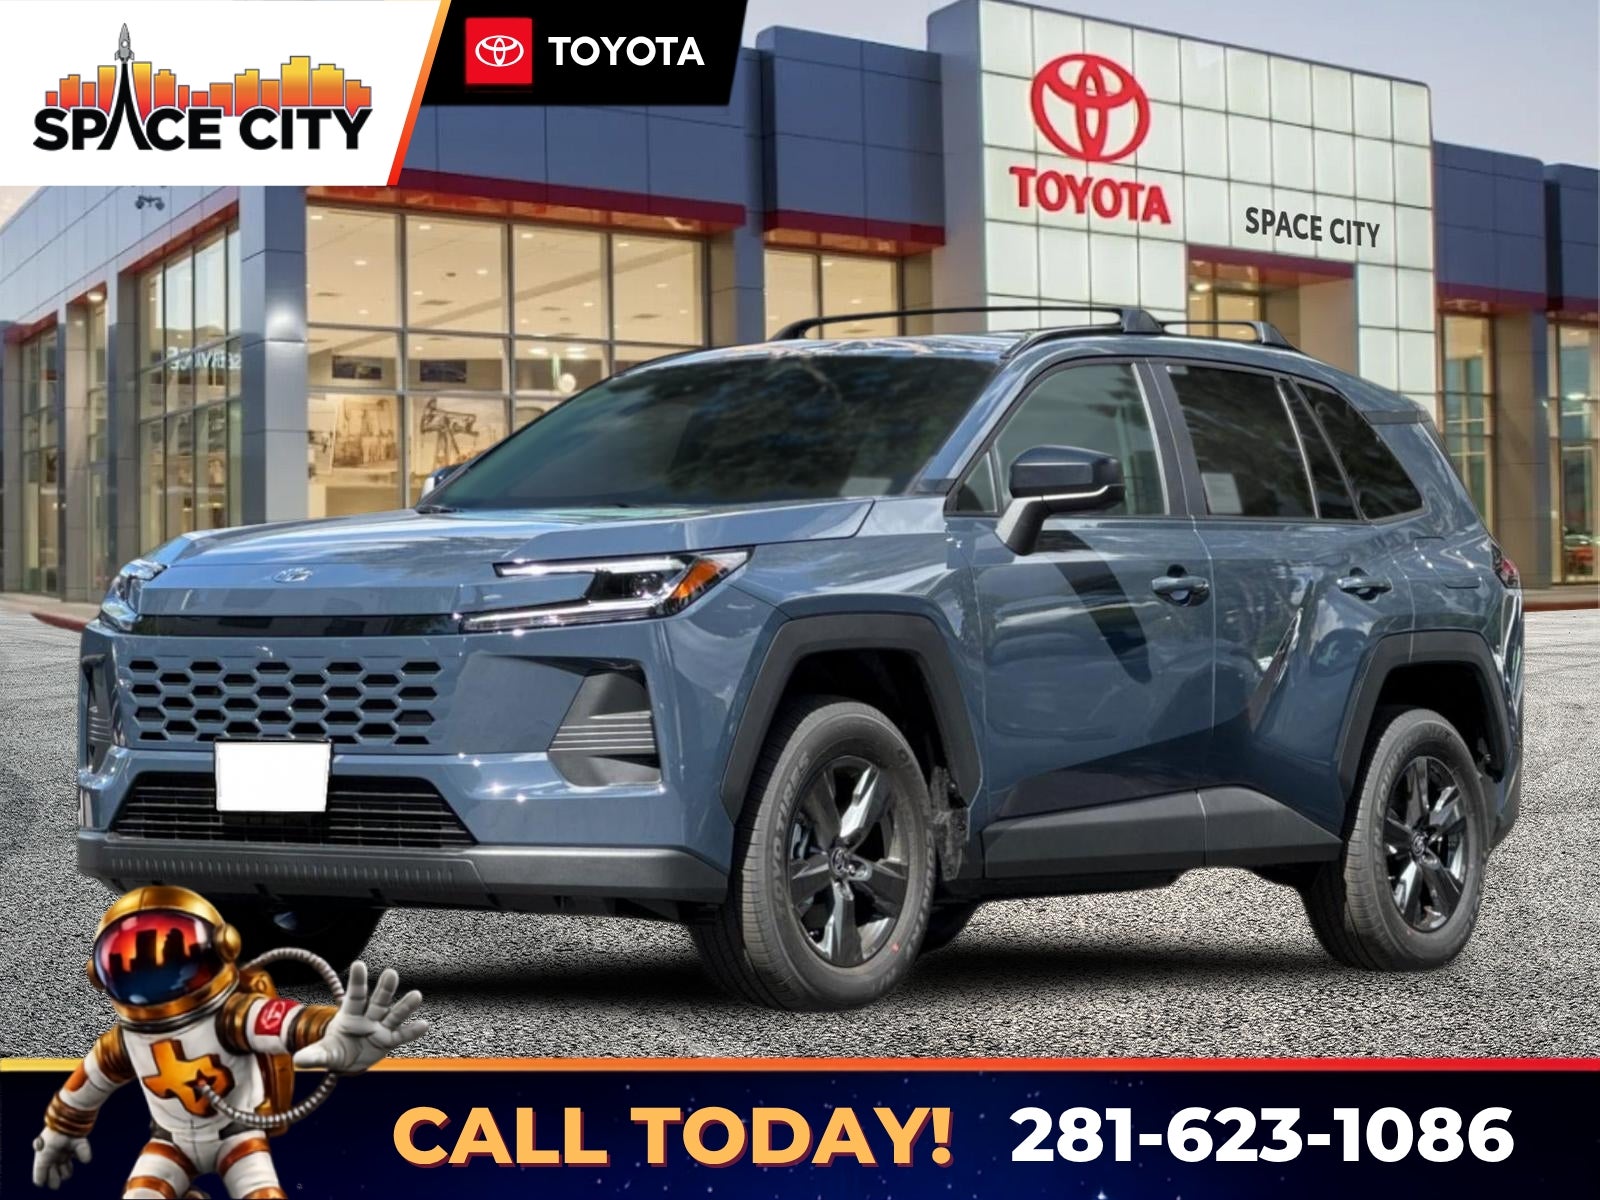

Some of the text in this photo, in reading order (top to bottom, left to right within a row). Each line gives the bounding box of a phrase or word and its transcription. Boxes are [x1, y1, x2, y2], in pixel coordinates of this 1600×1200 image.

[1009, 166, 1171, 224] TOYOTA
[1244, 206, 1380, 248] SPACE CITY
